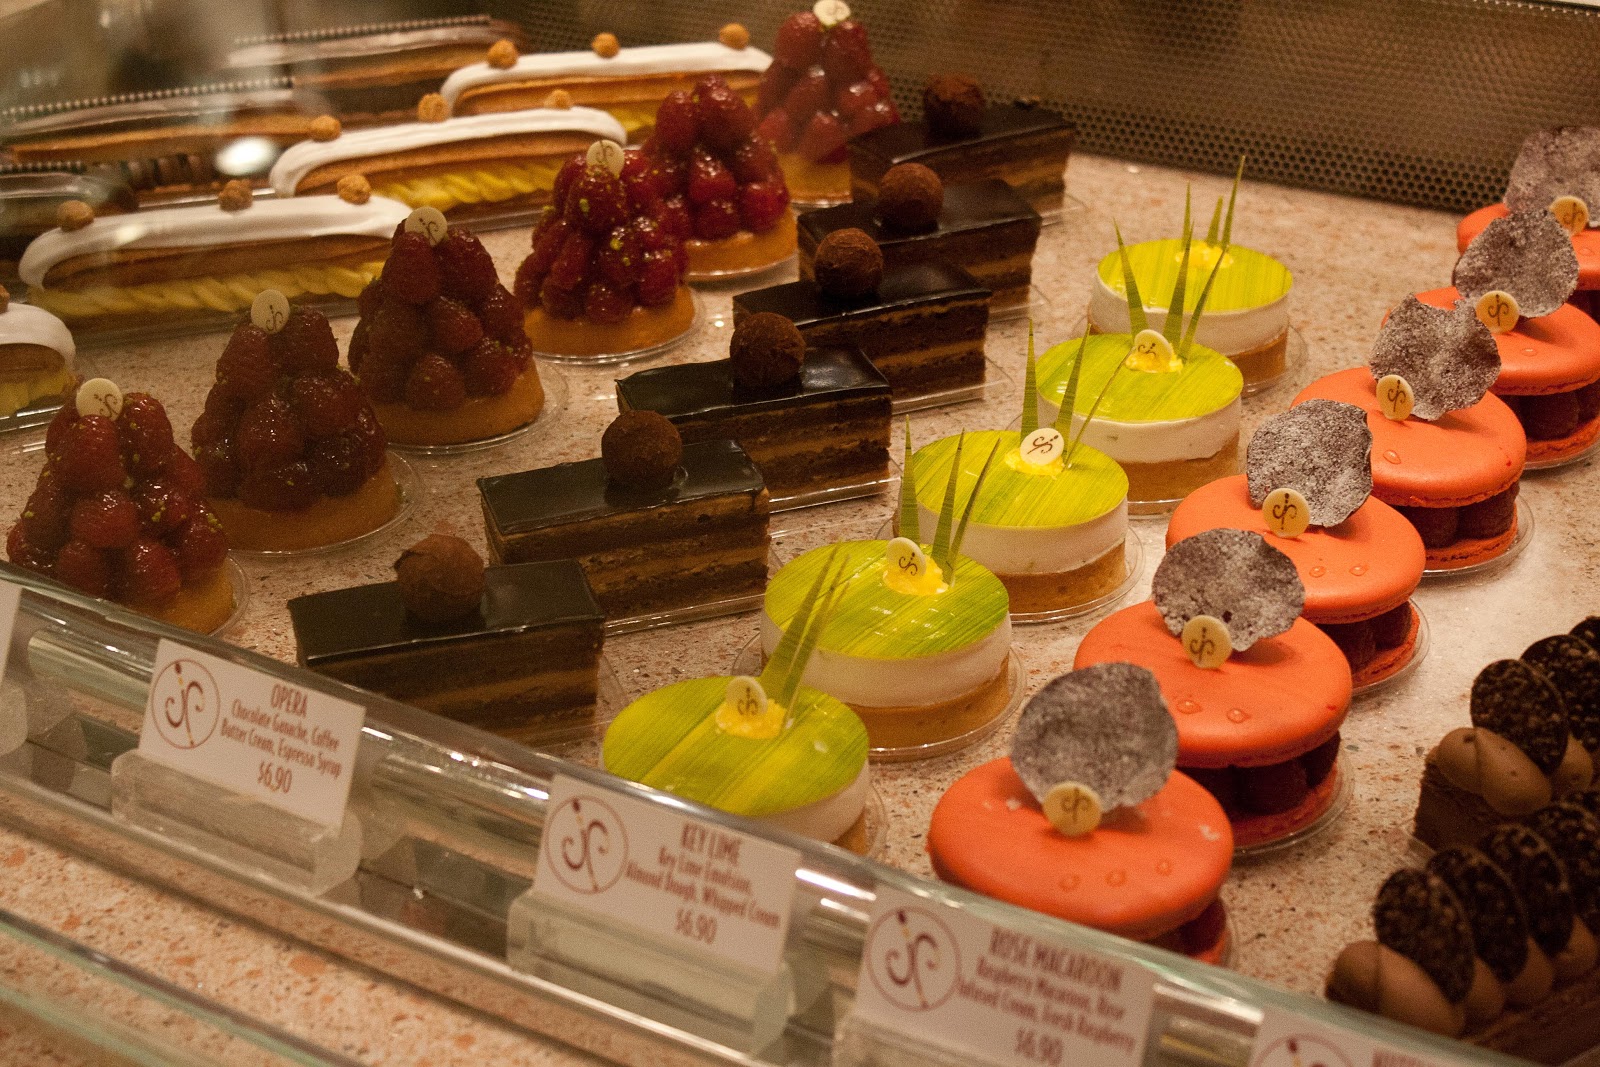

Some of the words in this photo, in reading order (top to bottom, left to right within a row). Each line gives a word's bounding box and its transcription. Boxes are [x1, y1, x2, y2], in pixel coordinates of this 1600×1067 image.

[271, 683, 308, 718] OPERA
[221, 718, 246, 744] Butter
[278, 738, 315, 768] Espresso
[317, 752, 342, 779] Syrup
[231, 699, 272, 727] Chocolate
[311, 726, 340, 751] Coffee
[680, 822, 708, 853] KEY
[708, 832, 742, 867] LIME
